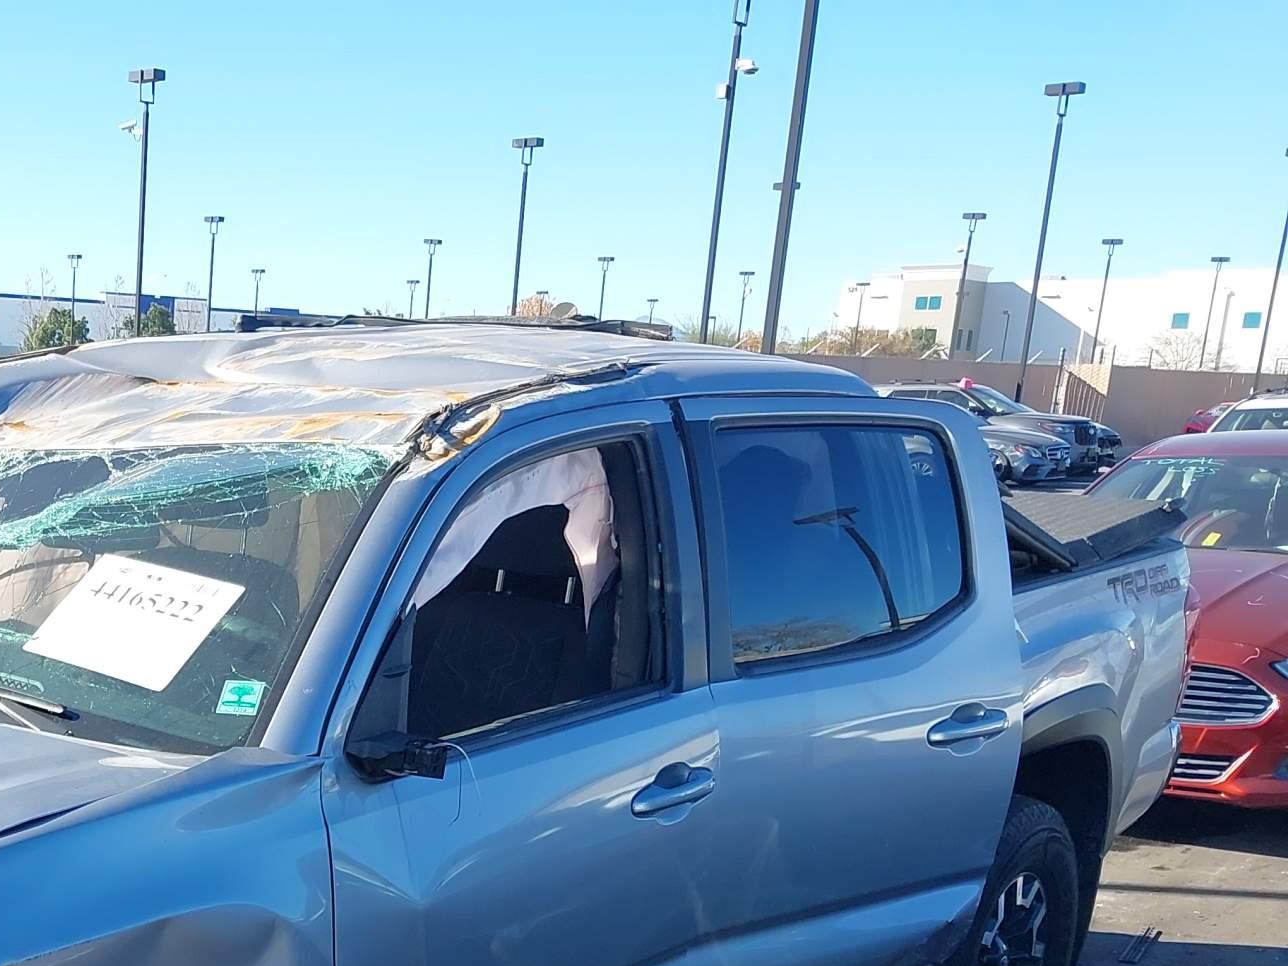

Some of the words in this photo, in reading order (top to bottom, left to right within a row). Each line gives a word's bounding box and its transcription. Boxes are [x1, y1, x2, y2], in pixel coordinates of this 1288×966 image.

[1144, 457, 1225, 466] TOTAL
[1167, 466, 1221, 475] LOSS
[1148, 564, 1169, 579] OFF
[1107, 568, 1146, 605] TRD
[1150, 577, 1181, 598] ROAD
[91, 581, 204, 622] 44165222
